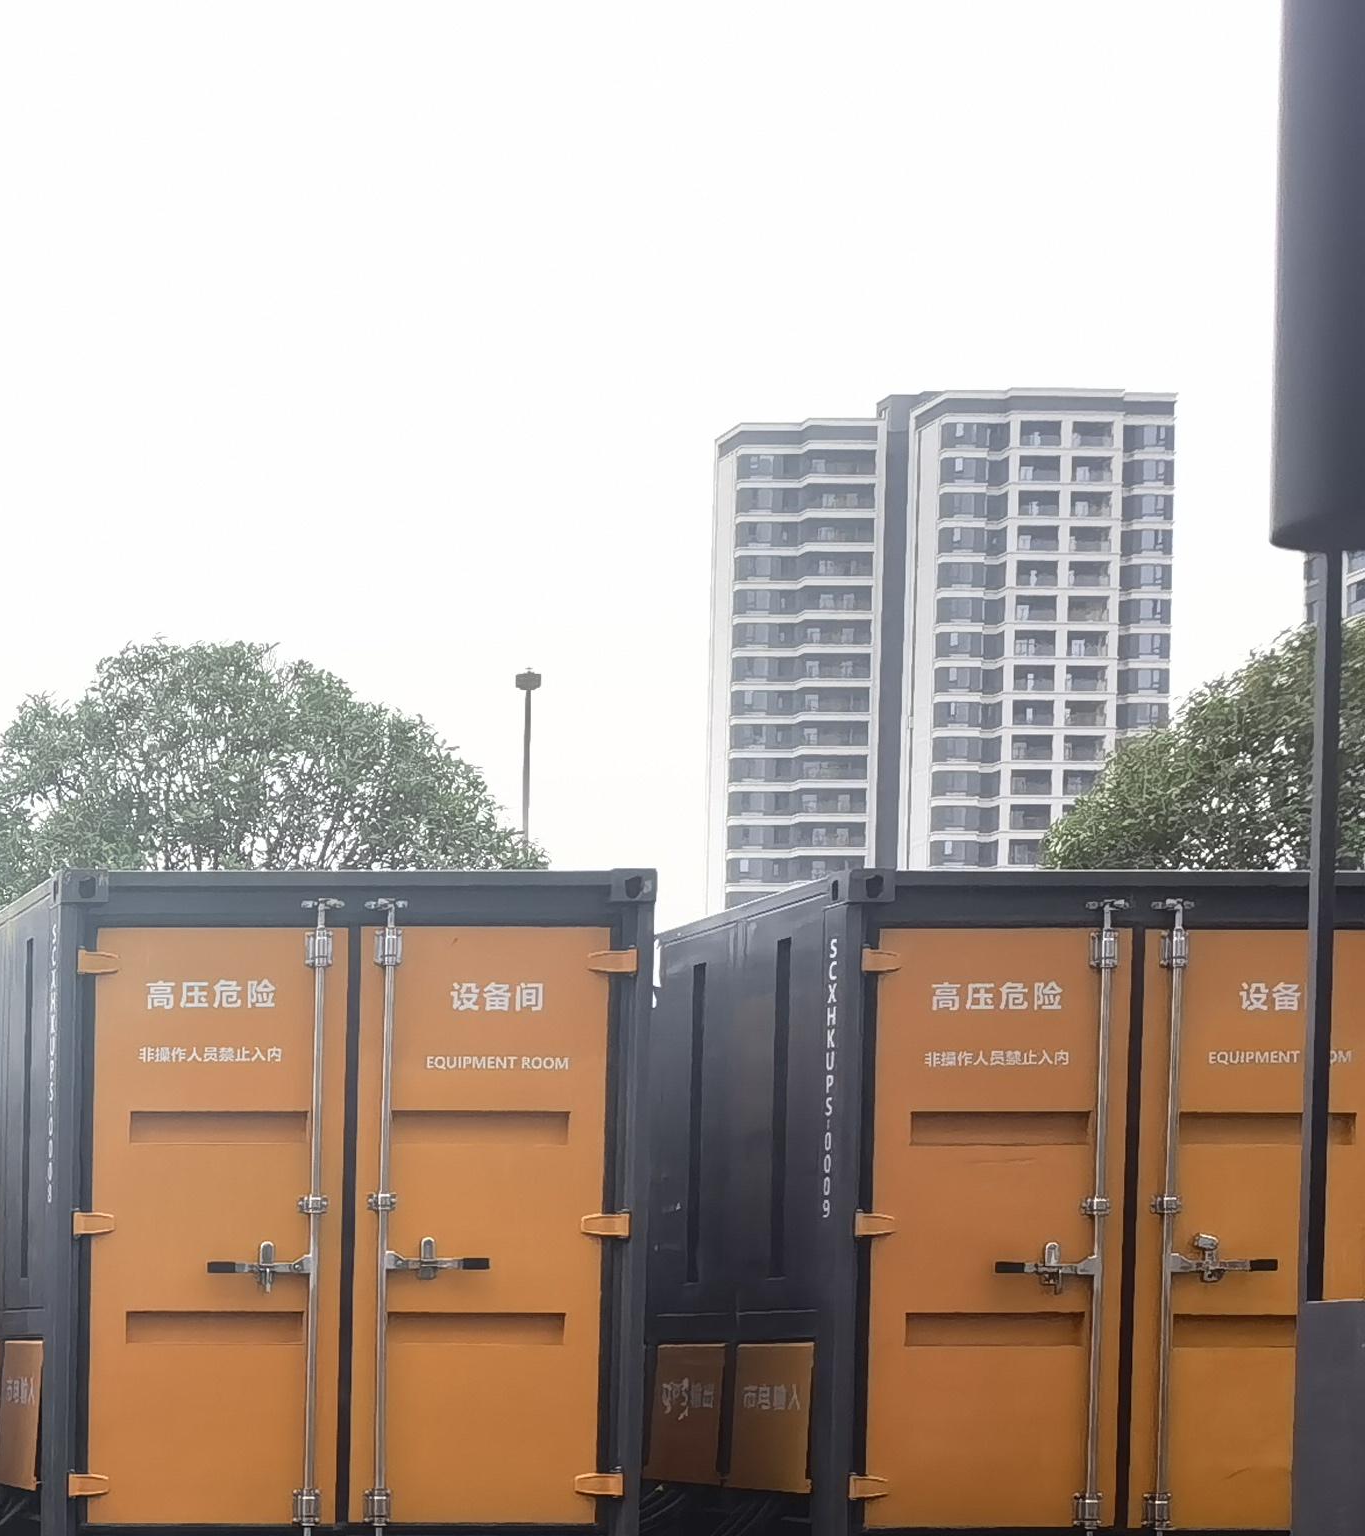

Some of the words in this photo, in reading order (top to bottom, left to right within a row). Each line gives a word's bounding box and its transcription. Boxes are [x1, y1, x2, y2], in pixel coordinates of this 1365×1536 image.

[146, 979, 276, 1010] 高压危险
[450, 982, 544, 1012] 设备间
[931, 981, 1063, 1011] 高压危险
[1239, 982, 1307, 1011] 设备
[426, 1056, 517, 1070] EQUIPMENT
[521, 1056, 569, 1070] ROOM
[1208, 1050, 1301, 1065] EQUIPMENT
